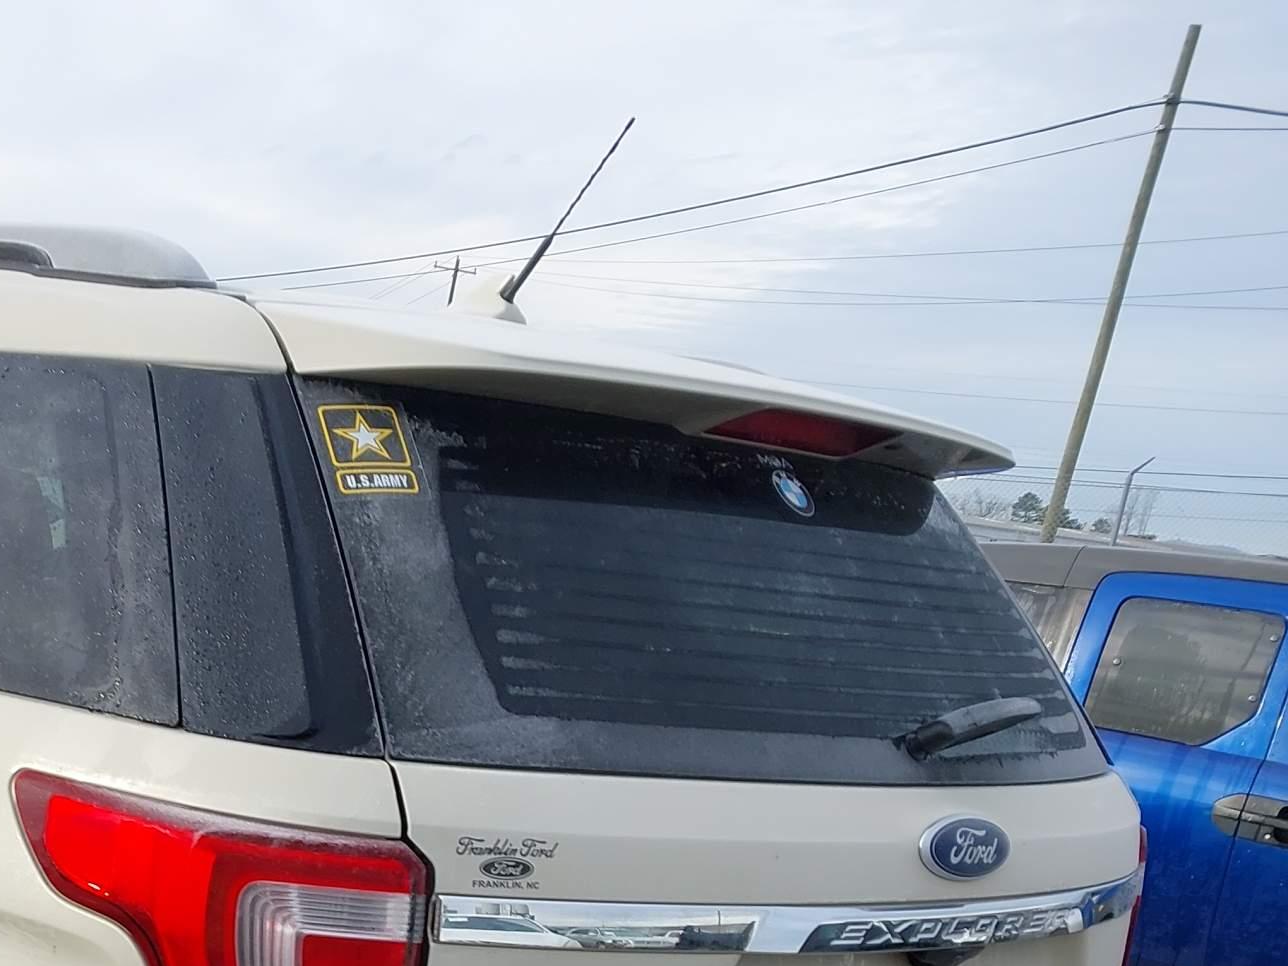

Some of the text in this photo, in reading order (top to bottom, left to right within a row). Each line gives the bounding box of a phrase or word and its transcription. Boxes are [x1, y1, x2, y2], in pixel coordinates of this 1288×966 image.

[455, 836, 559, 858] Franklin Ford
[950, 826, 998, 864] Ford
[490, 860, 523, 876] Ford
[526, 881, 540, 890] NC
[829, 907, 1072, 946] EXPLORER
